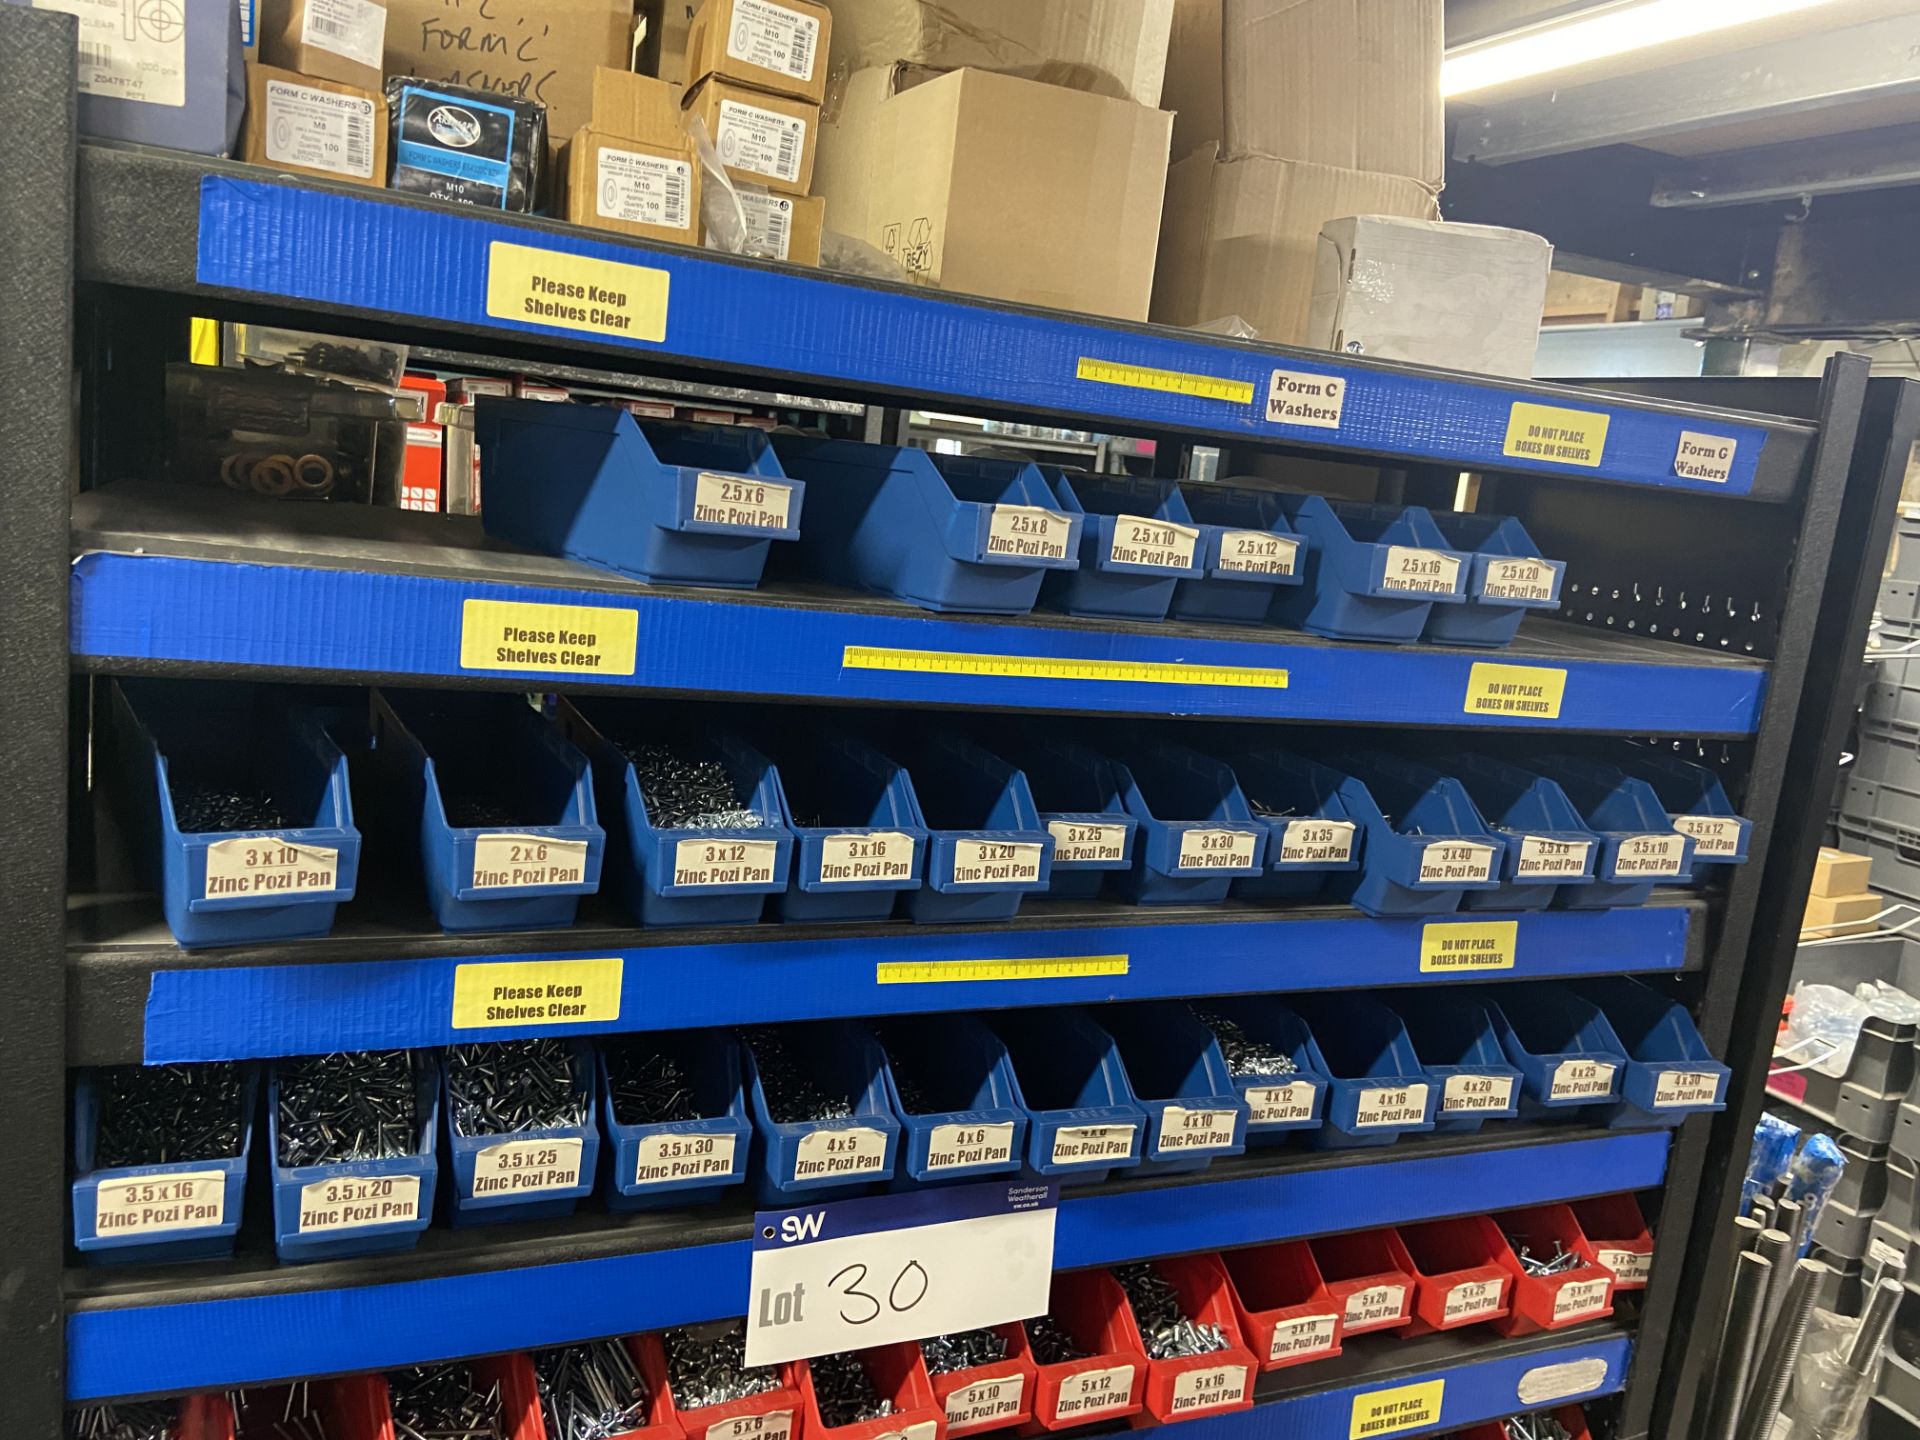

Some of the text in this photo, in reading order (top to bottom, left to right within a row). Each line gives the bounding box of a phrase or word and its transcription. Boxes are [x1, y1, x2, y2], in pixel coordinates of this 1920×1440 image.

[742, 0, 761, 10] FORM
[768, 8, 798, 23] WASHERS
[422, 18, 507, 55] FORM
[764, 29, 779, 39] M10
[774, 50, 786, 59] 100
[270, 86, 357, 110] FORM C WASHERS
[728, 106, 746, 116] FORM
[754, 112, 785, 126] WASHERS
[314, 122, 326, 130] M8
[752, 133, 766, 142] M10
[324, 143, 339, 152] 100
[606, 154, 628, 163] FORM
[635, 160, 669, 170] WASHERS
[446, 182, 464, 194] M10
[634, 181, 650, 190] M10
[646, 202, 659, 210] 100
[532, 276, 627, 308] Please Keep
[524, 298, 631, 329] Shelves Clear
[1276, 376, 1338, 398] Form C
[1269, 399, 1338, 421] Washers
[1528, 424, 1586, 444] DO NOT PLACE
[1515, 440, 1590, 460] BOXES ON SHELVES
[1682, 442, 1728, 460] Form G
[1676, 460, 1726, 480] Washers
[721, 483, 741, 501] 2.5
[757, 487, 764, 503] 6
[696, 505, 784, 528] Zinc Pozi Pan
[1011, 516, 1028, 531] 2.5
[1040, 519, 1047, 533] 8
[989, 536, 1062, 557] Zinc Pozi Pan
[503, 627, 596, 647] Please Keep
[496, 647, 601, 666] Shelves Clear
[1488, 683, 1543, 697] DO NOT PLACE
[1476, 698, 1550, 712] BOXES ON SHELVES
[1202, 835, 1208, 849] 3
[1219, 835, 1233, 848] 30
[246, 849, 256, 865] 3
[278, 848, 298, 864] 10
[510, 846, 520, 861] 2
[537, 845, 547, 860] 6
[706, 847, 715, 861] 3
[730, 845, 744, 860] 12
[1180, 854, 1249, 867] Zinc Pozi Pan
[208, 871, 331, 894] Zinc Pozi Pan
[474, 868, 578, 886] Zinc Pozi Pan
[676, 867, 770, 885] Zinc Pozi Pan
[1442, 939, 1496, 950] DO NOT PLACE
[1430, 953, 1503, 966] BOXES ON SHELVES
[493, 984, 582, 1000] Please Keep
[486, 1003, 587, 1020] Shelves Clear
[1183, 1114, 1191, 1127] 4
[1201, 1113, 1212, 1126] 10
[659, 1143, 681, 1157] 3.5
[695, 1139, 713, 1153] 30
[827, 1138, 835, 1151] 4
[848, 1137, 856, 1150] 5
[1160, 1131, 1229, 1147] Zinc Pozi Pan
[638, 1159, 729, 1180] Zinc Pozi Pan
[797, 1155, 880, 1174] Zinc Pozi Pan
[126, 1187, 150, 1202] 3.5
[174, 1183, 193, 1198] 16
[1008, 1185, 1049, 1196] Sanderson
[1008, 1192, 1048, 1204] Weatherall
[99, 1205, 217, 1228] Zinc Pozi Pan
[780, 1210, 826, 1242] SW
[827, 1260, 929, 1325] 30
[758, 1282, 806, 1328] Lot
[1081, 1379, 1088, 1392] 5
[1100, 1376, 1110, 1389] 12
[1196, 1377, 1202, 1389] 5
[1213, 1373, 1224, 1386] 16
[1059, 1392, 1127, 1412] Zinc Pozi Pan
[1174, 1389, 1241, 1409] Zinc Pozi Pan
[1371, 1398, 1423, 1418] DO NOT PLACE
[1360, 1410, 1430, 1433] BOXES ON SHELVES
